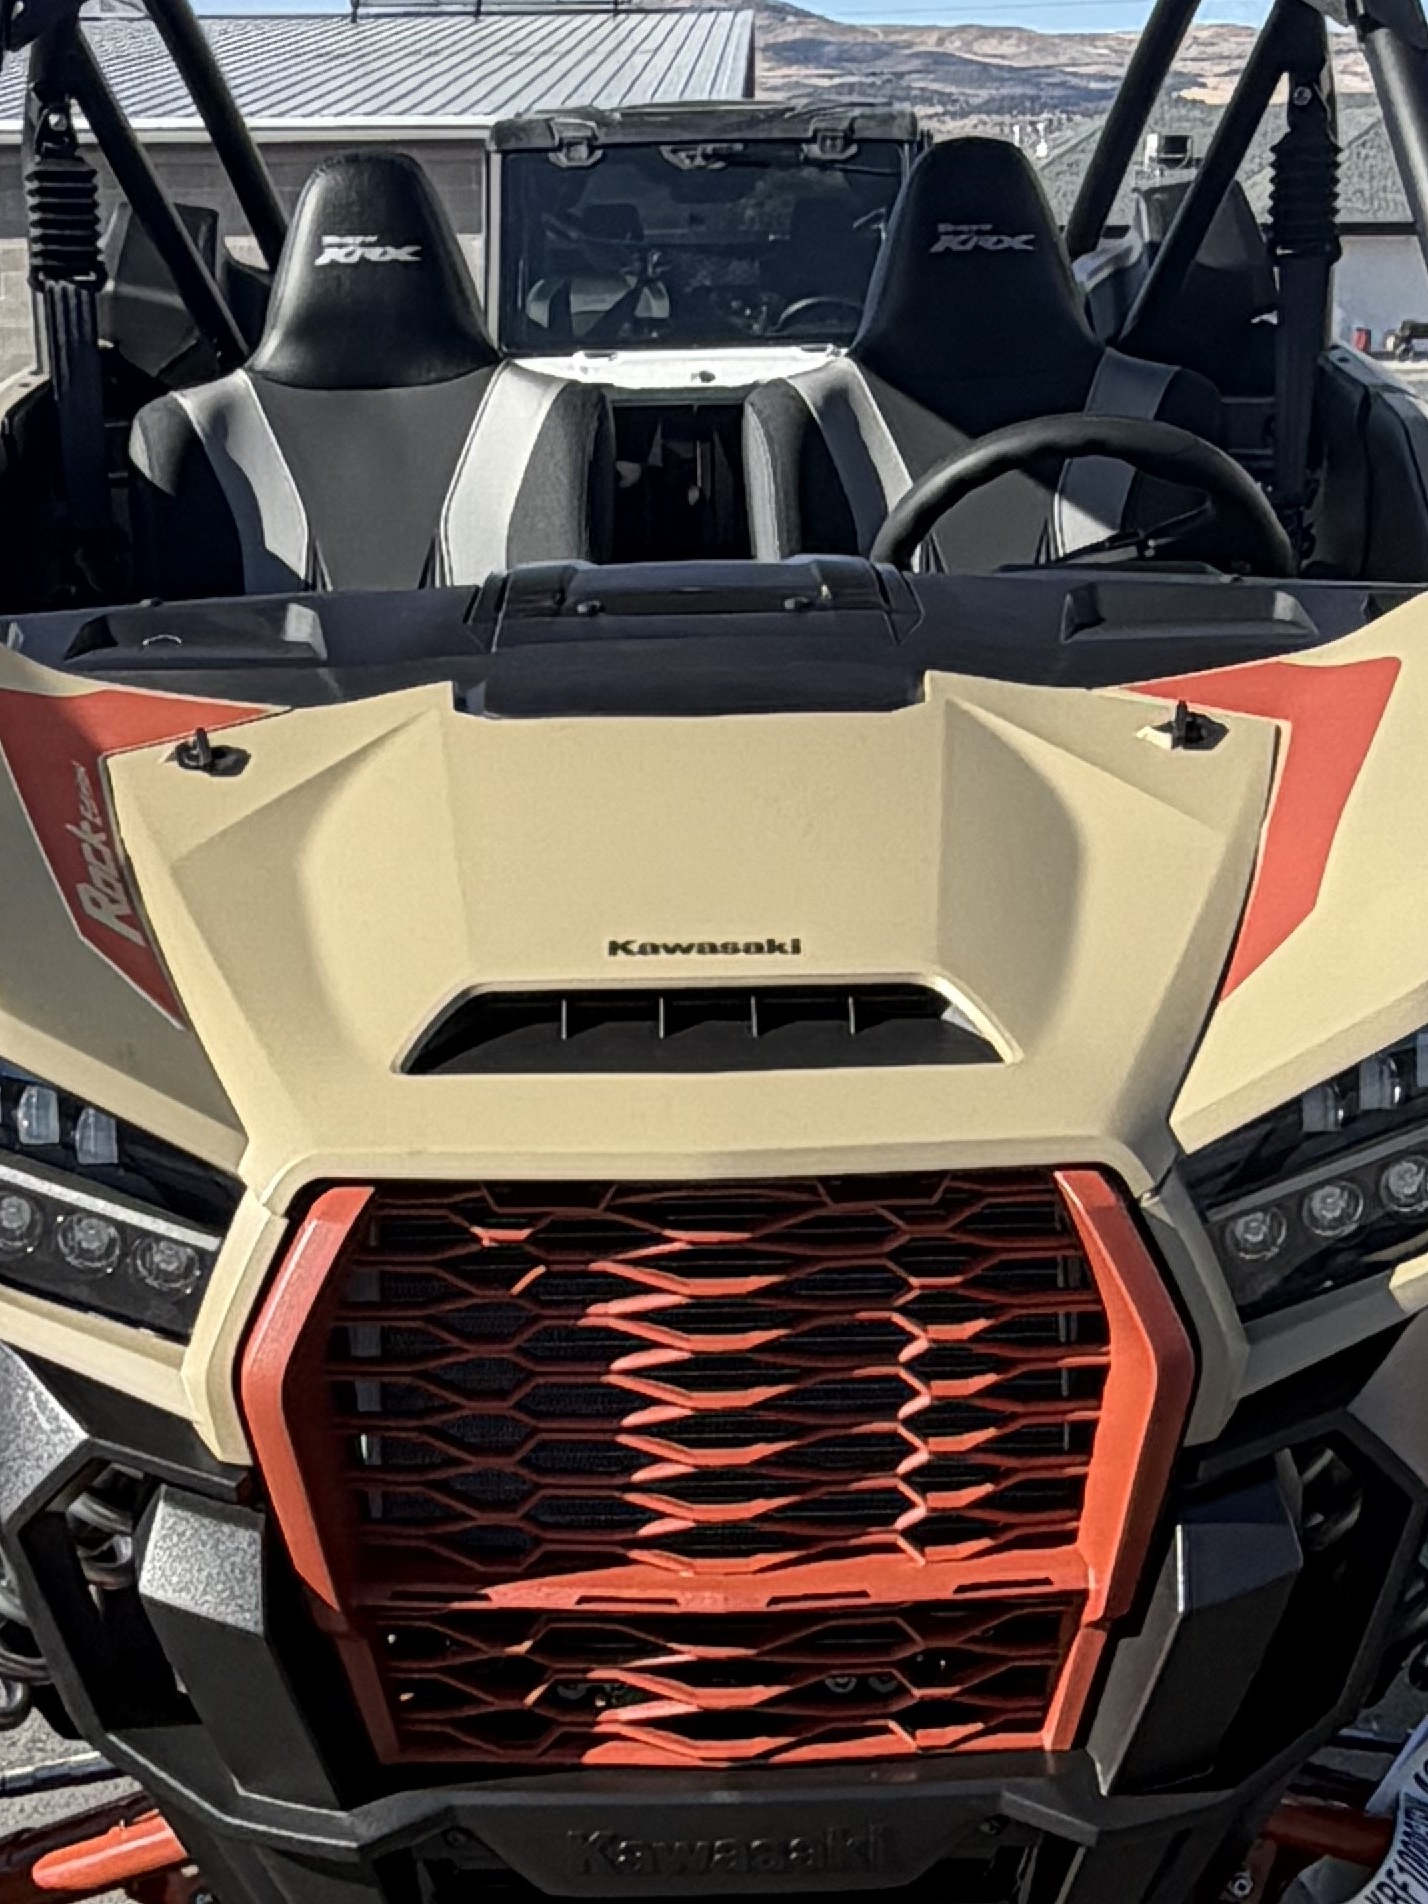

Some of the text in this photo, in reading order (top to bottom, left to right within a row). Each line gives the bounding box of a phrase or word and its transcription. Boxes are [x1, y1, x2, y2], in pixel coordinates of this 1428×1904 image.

[64, 822, 149, 947] Rock
[607, 938, 802, 957] Kawasaki
[567, 1824, 890, 1876] Kawasaki
